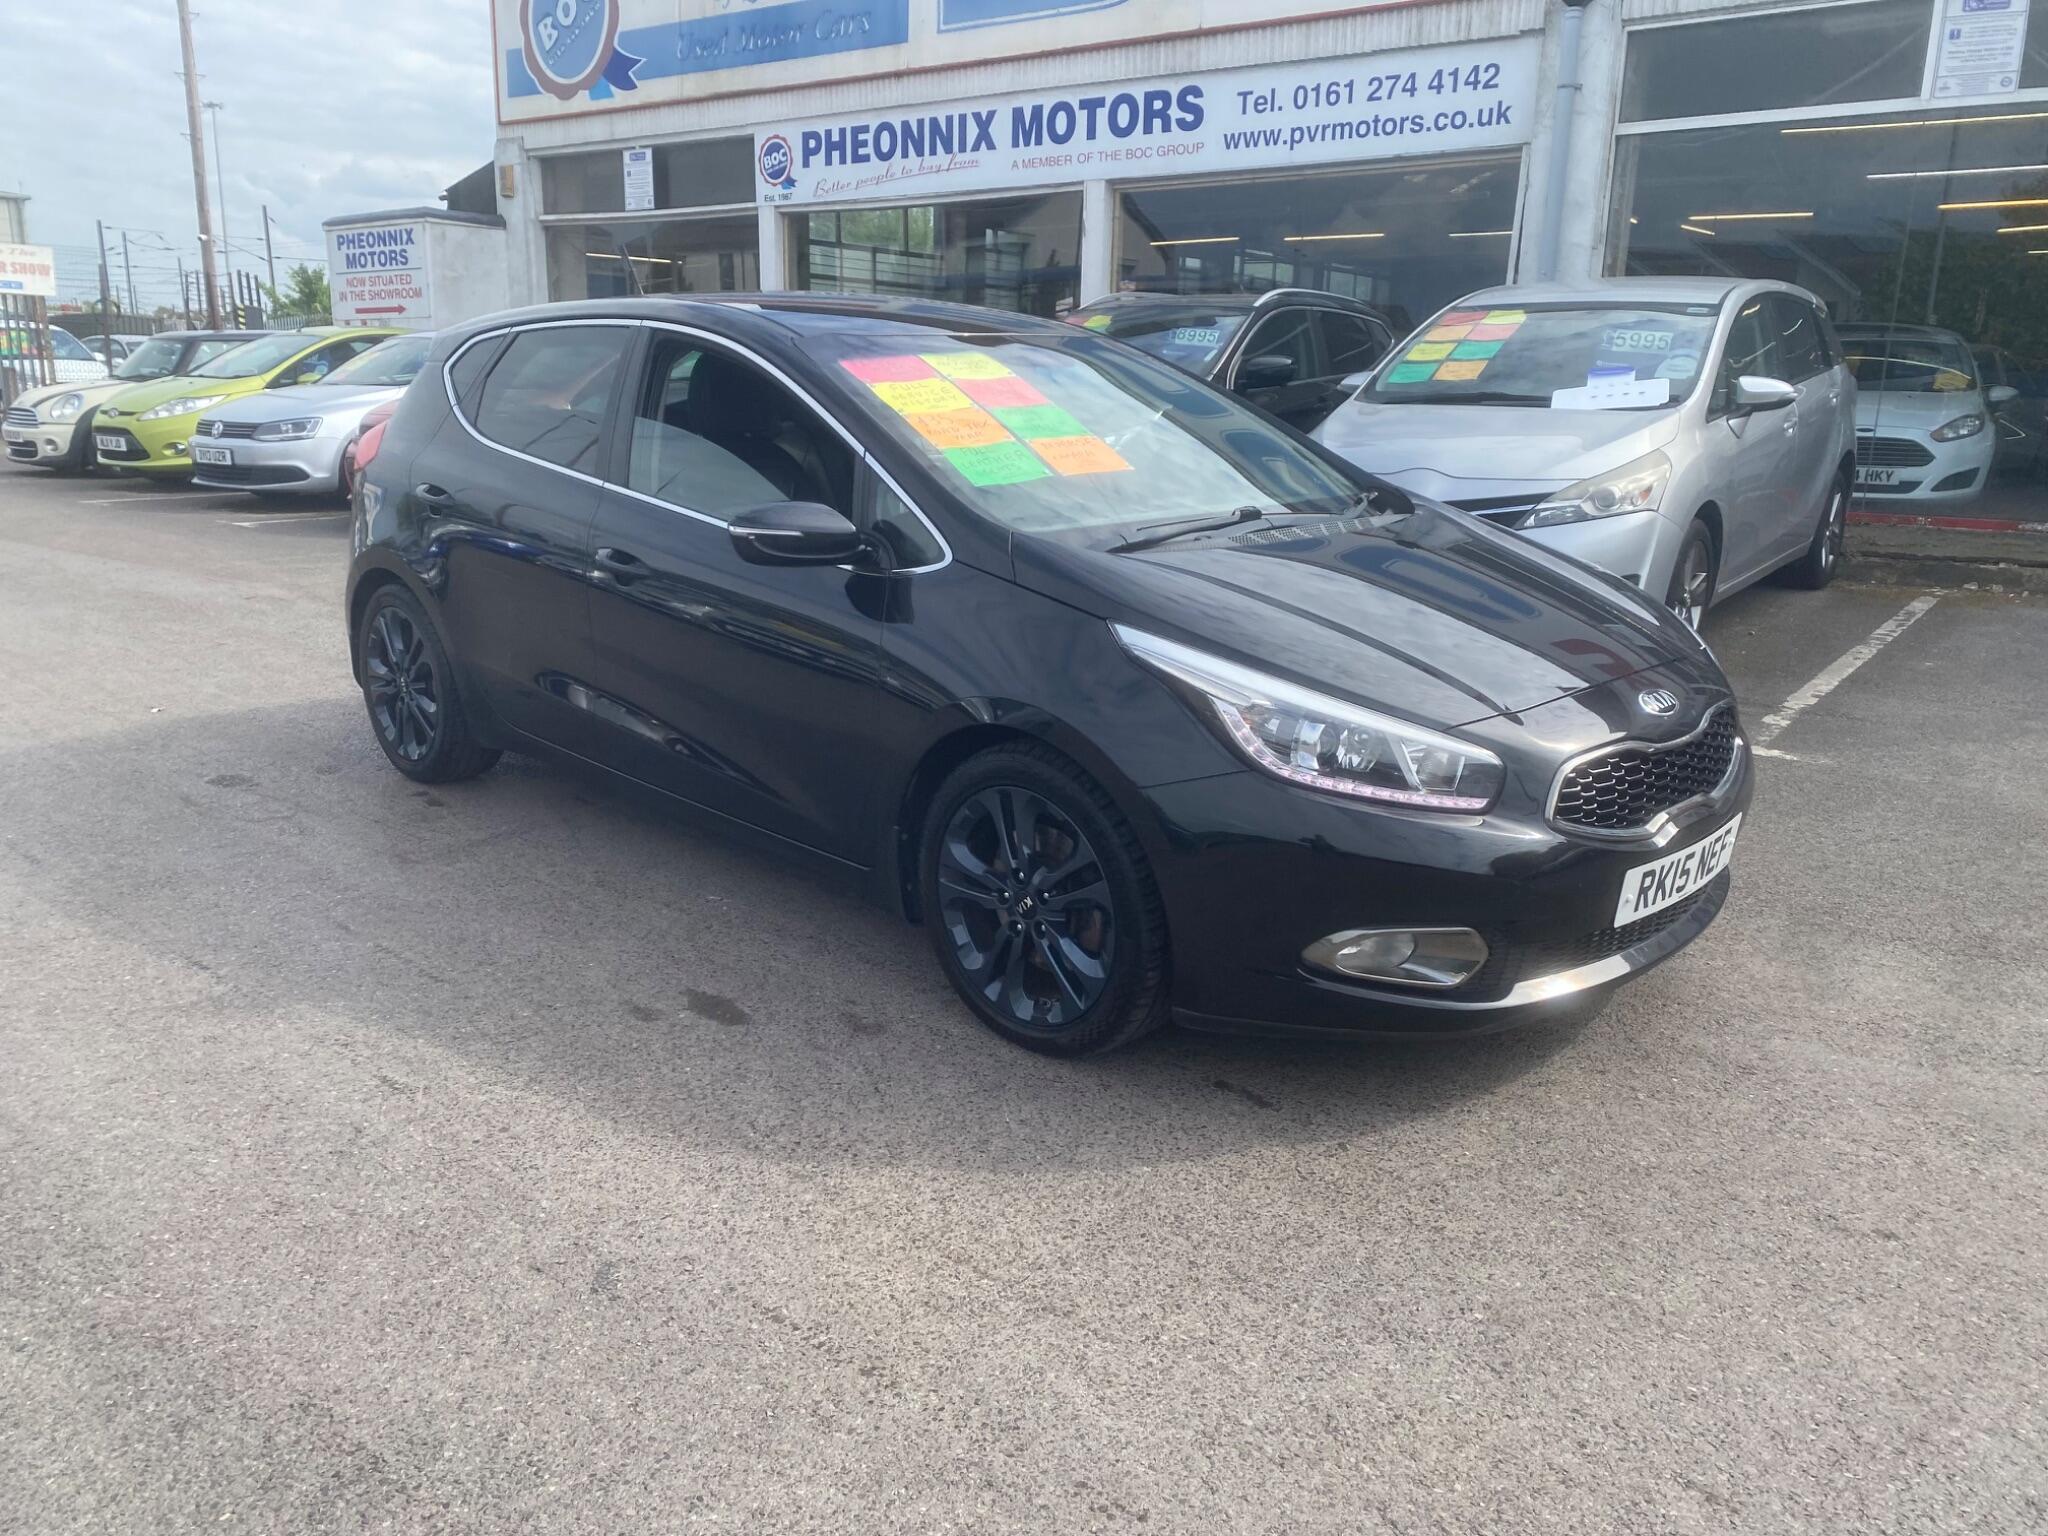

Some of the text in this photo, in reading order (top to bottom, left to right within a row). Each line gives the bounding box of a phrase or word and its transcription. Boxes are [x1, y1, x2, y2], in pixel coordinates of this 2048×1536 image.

[815, 8, 872, 40] Cars
[1237, 63, 1501, 115] Tel. 0161 274 4142
[802, 85, 1205, 168] PHEONNIX MOTORS
[1223, 101, 1512, 150] www.pvrmotors.co.uk
[763, 149, 787, 169] BOC
[1011, 142, 1205, 170] A MEMBER OF THE BOC GROUP
[812, 152, 980, 199] Better people to buy from
[336, 228, 415, 251] PHEONNIX
[10, 261, 51, 277] SHOW
[345, 248, 409, 269] MOTORS
[345, 273, 413, 288] NOW SITUATED
[339, 287, 423, 302] IN THE SHOWROOM
[1864, 469, 1895, 482] HKY
[1646, 690, 1676, 711] KIA
[1634, 827, 1733, 912] RK15 NEF
